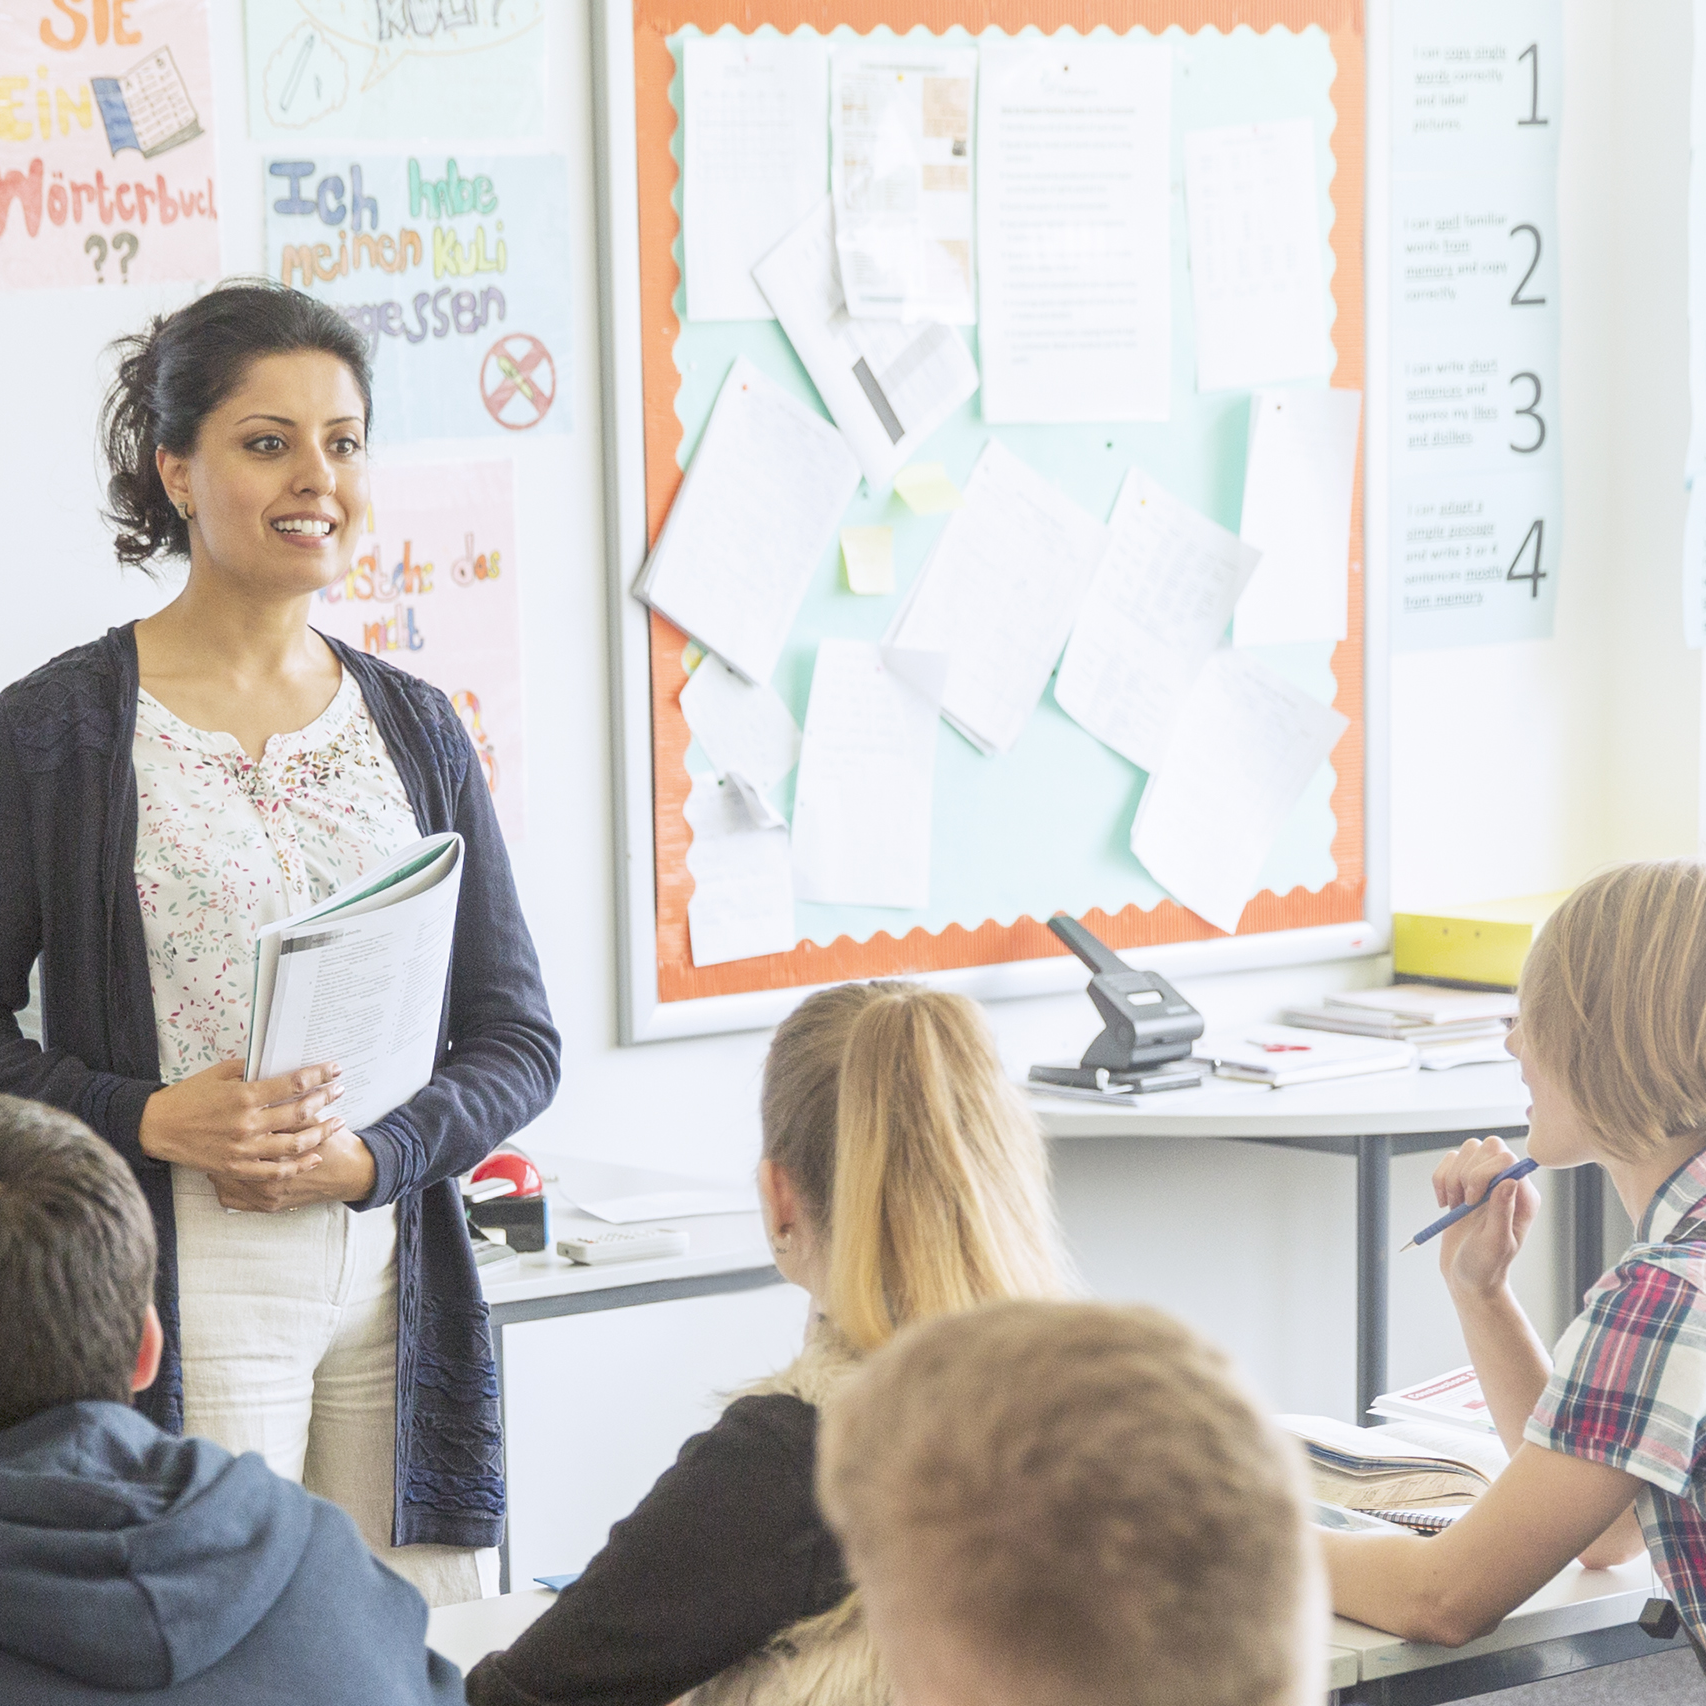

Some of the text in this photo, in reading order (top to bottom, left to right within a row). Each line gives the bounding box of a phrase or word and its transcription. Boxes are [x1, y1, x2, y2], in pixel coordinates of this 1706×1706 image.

[1516, 42, 1550, 127] 1
[269, 161, 378, 231] Ich
[1508, 223, 1546, 307] 2
[1507, 371, 1546, 455] 3
[450, 531, 502, 588] das
[1506, 518, 1548, 599] 4
[362, 603, 425, 654] nicht
